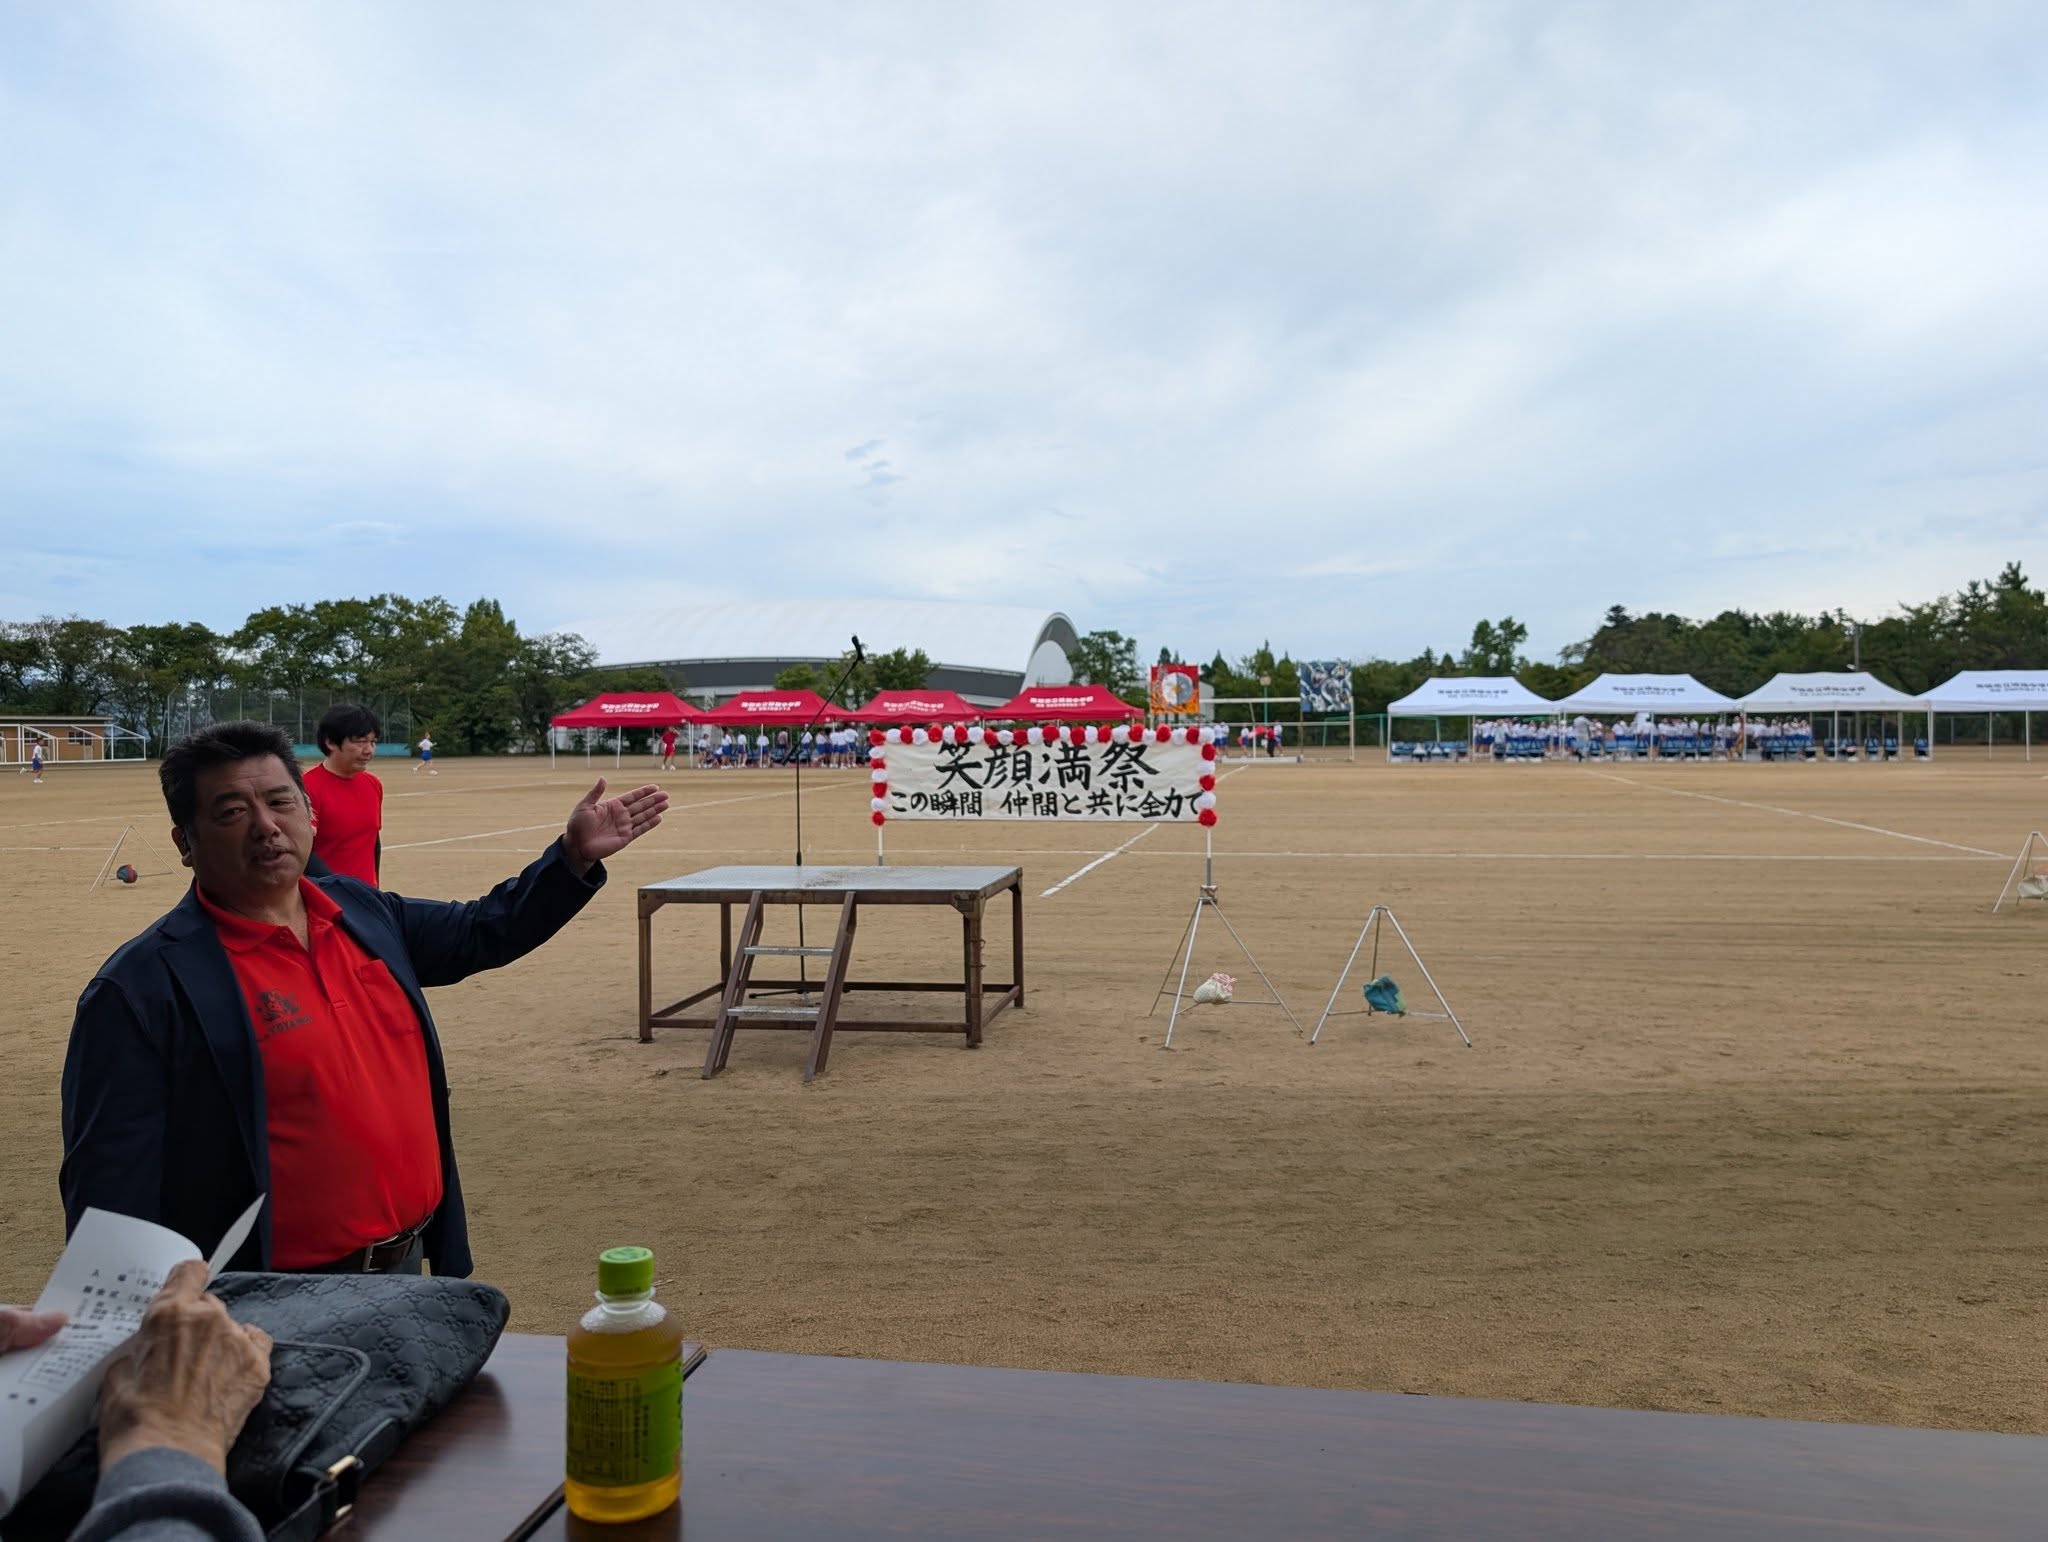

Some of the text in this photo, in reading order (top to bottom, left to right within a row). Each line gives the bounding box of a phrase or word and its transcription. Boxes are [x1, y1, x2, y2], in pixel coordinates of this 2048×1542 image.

[934, 739, 1160, 794] 笑顔満祭
[890, 788, 984, 817] この瞬間
